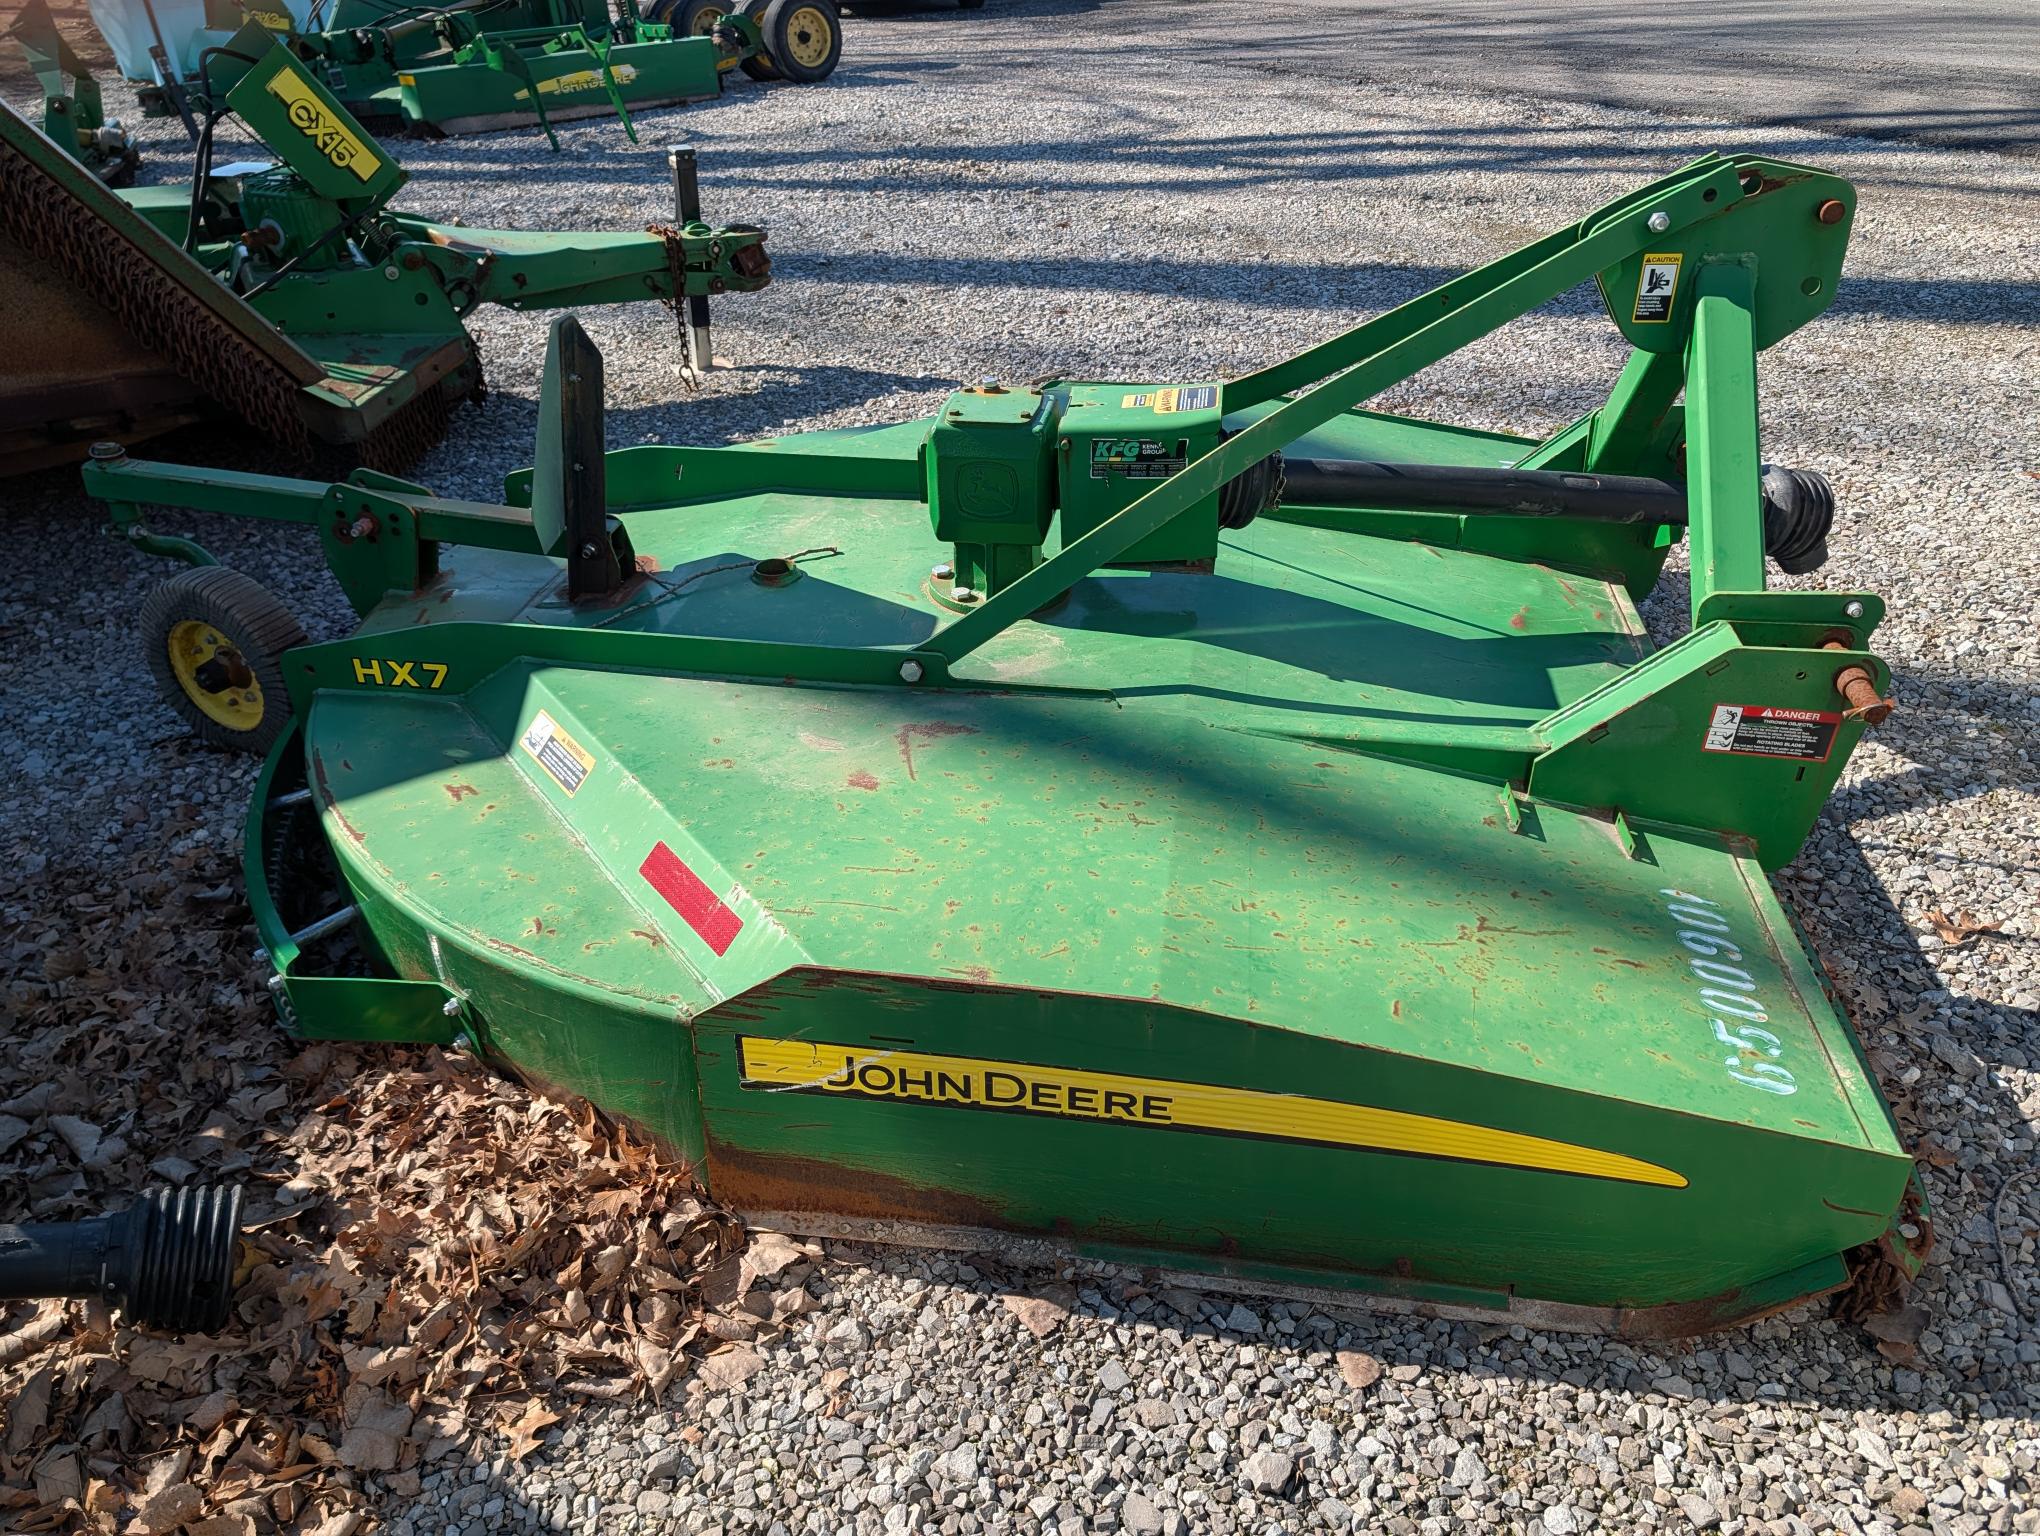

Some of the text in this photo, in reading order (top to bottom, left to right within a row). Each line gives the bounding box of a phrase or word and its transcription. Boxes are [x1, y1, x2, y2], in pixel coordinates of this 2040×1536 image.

[588, 73, 633, 88] DERE
[289, 98, 358, 168] CX15
[1094, 441, 1140, 457] KFG
[351, 657, 449, 689] HX7
[1774, 709, 1820, 720] DANGER
[1658, 888, 1798, 1096] 6500901
[828, 1055, 1174, 1122] JOHN DEERE
